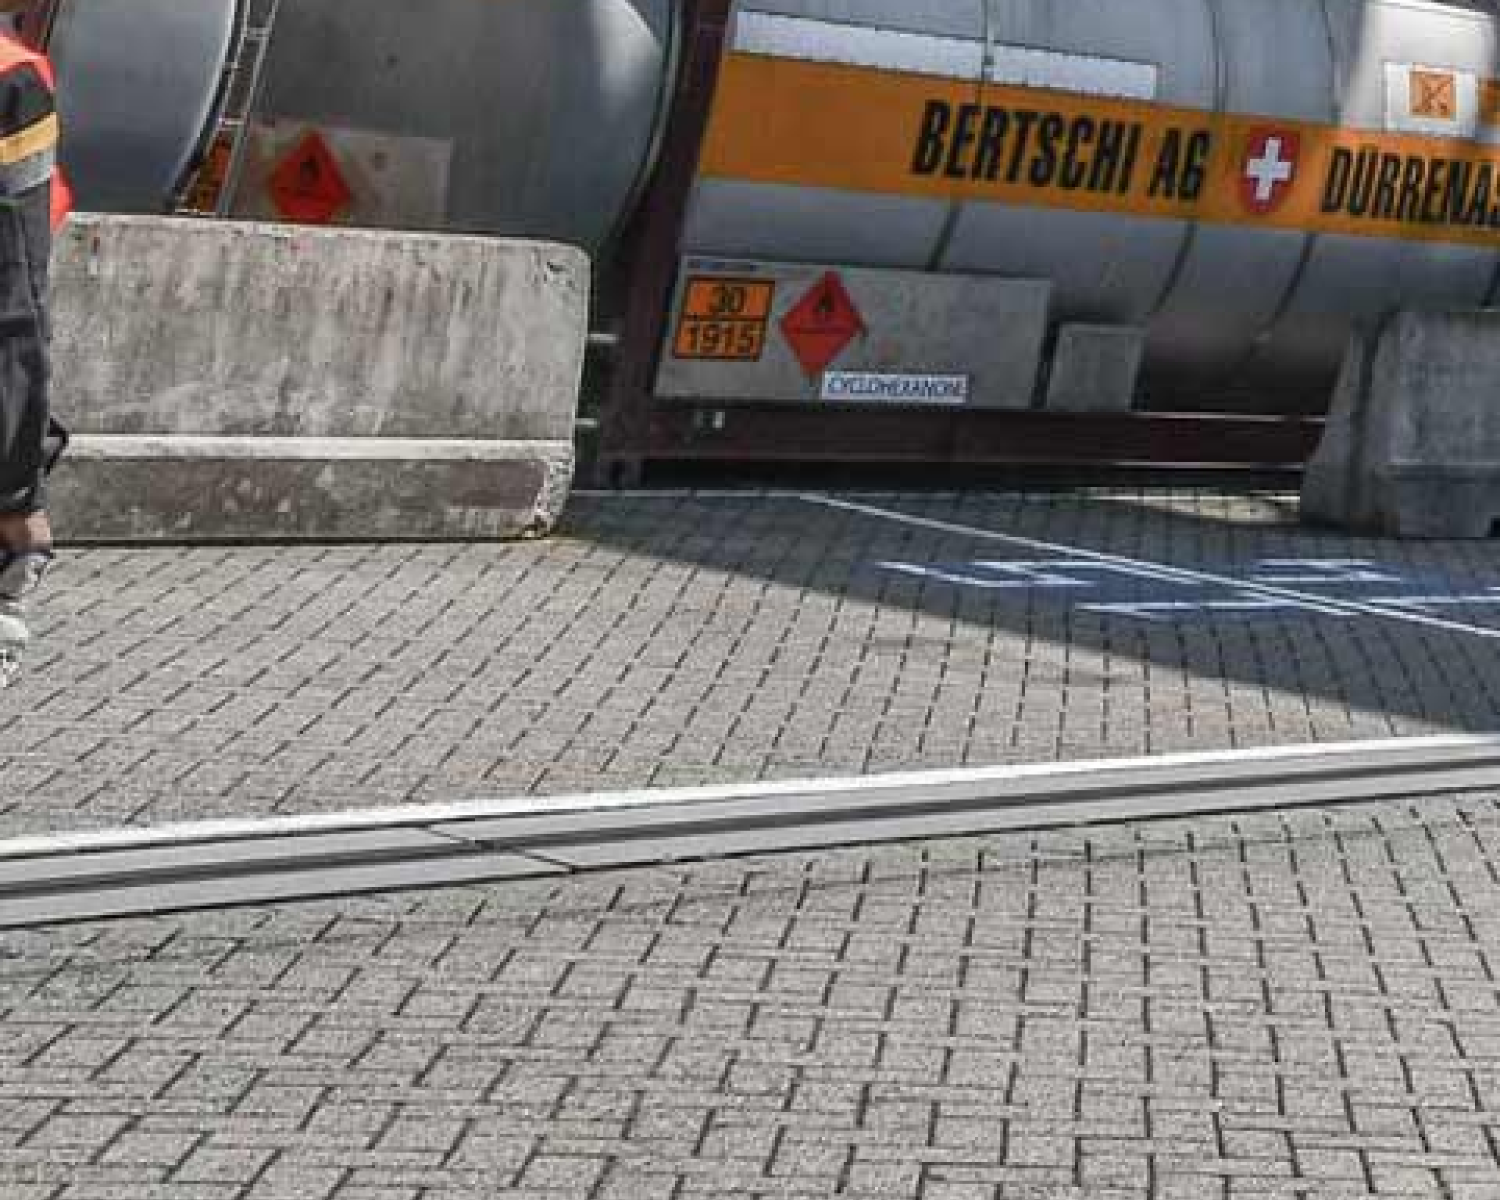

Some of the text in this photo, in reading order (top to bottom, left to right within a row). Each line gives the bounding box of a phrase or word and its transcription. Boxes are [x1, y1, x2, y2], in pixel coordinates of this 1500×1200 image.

[910, 98, 1211, 202] BERTSCHI AG
[709, 282, 746, 317] 30
[684, 322, 754, 354] 1915
